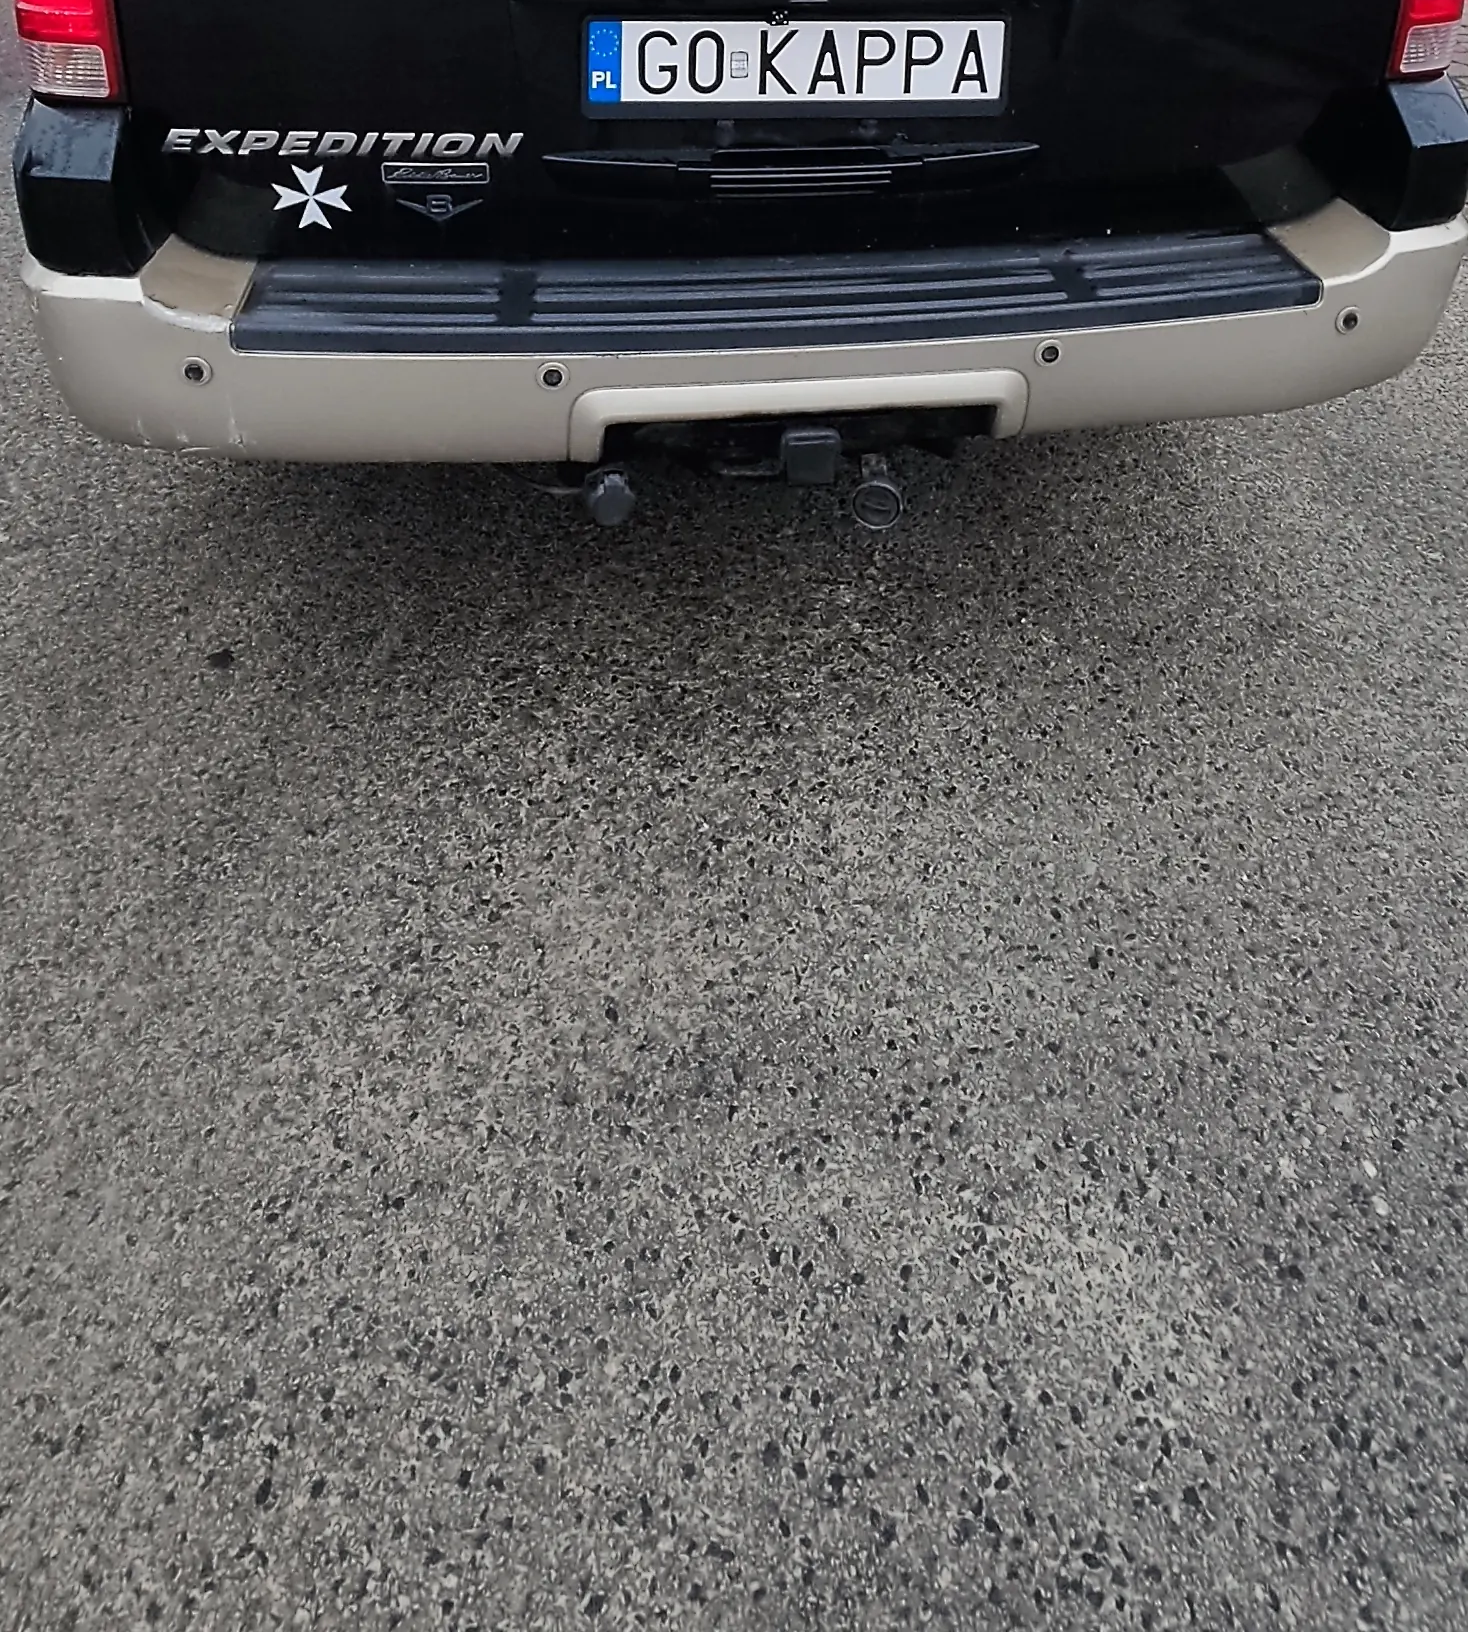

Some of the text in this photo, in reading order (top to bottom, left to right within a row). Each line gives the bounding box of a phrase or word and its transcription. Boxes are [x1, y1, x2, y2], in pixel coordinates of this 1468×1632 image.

[637, 29, 988, 95] GO KAPPA
[591, 71, 617, 89] PL
[162, 128, 524, 157] EXPEDITION
